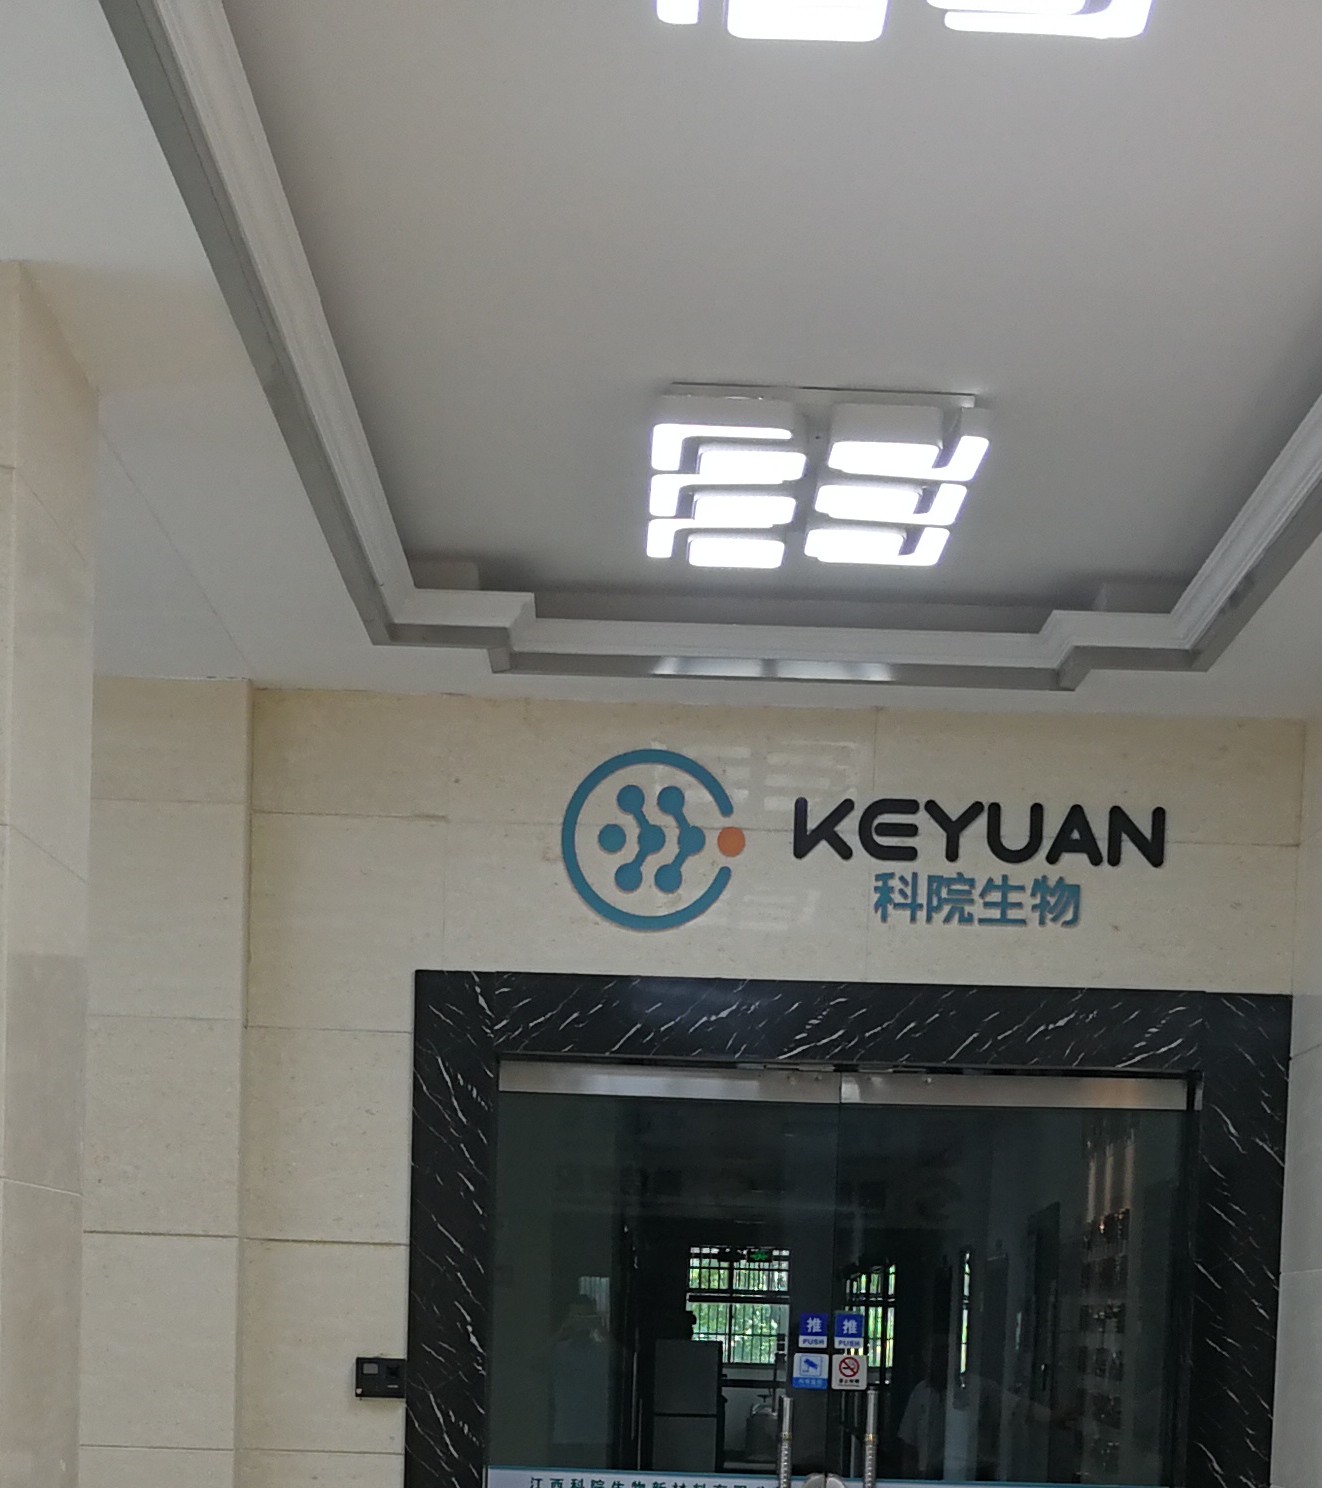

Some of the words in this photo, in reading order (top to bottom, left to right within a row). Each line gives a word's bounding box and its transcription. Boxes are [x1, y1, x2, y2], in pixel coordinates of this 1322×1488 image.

[792, 797, 1166, 868] KEYUAN
[872, 872, 1081, 928] 科院生物
[805, 1317, 822, 1333] 推
[842, 1319, 858, 1335] 推
